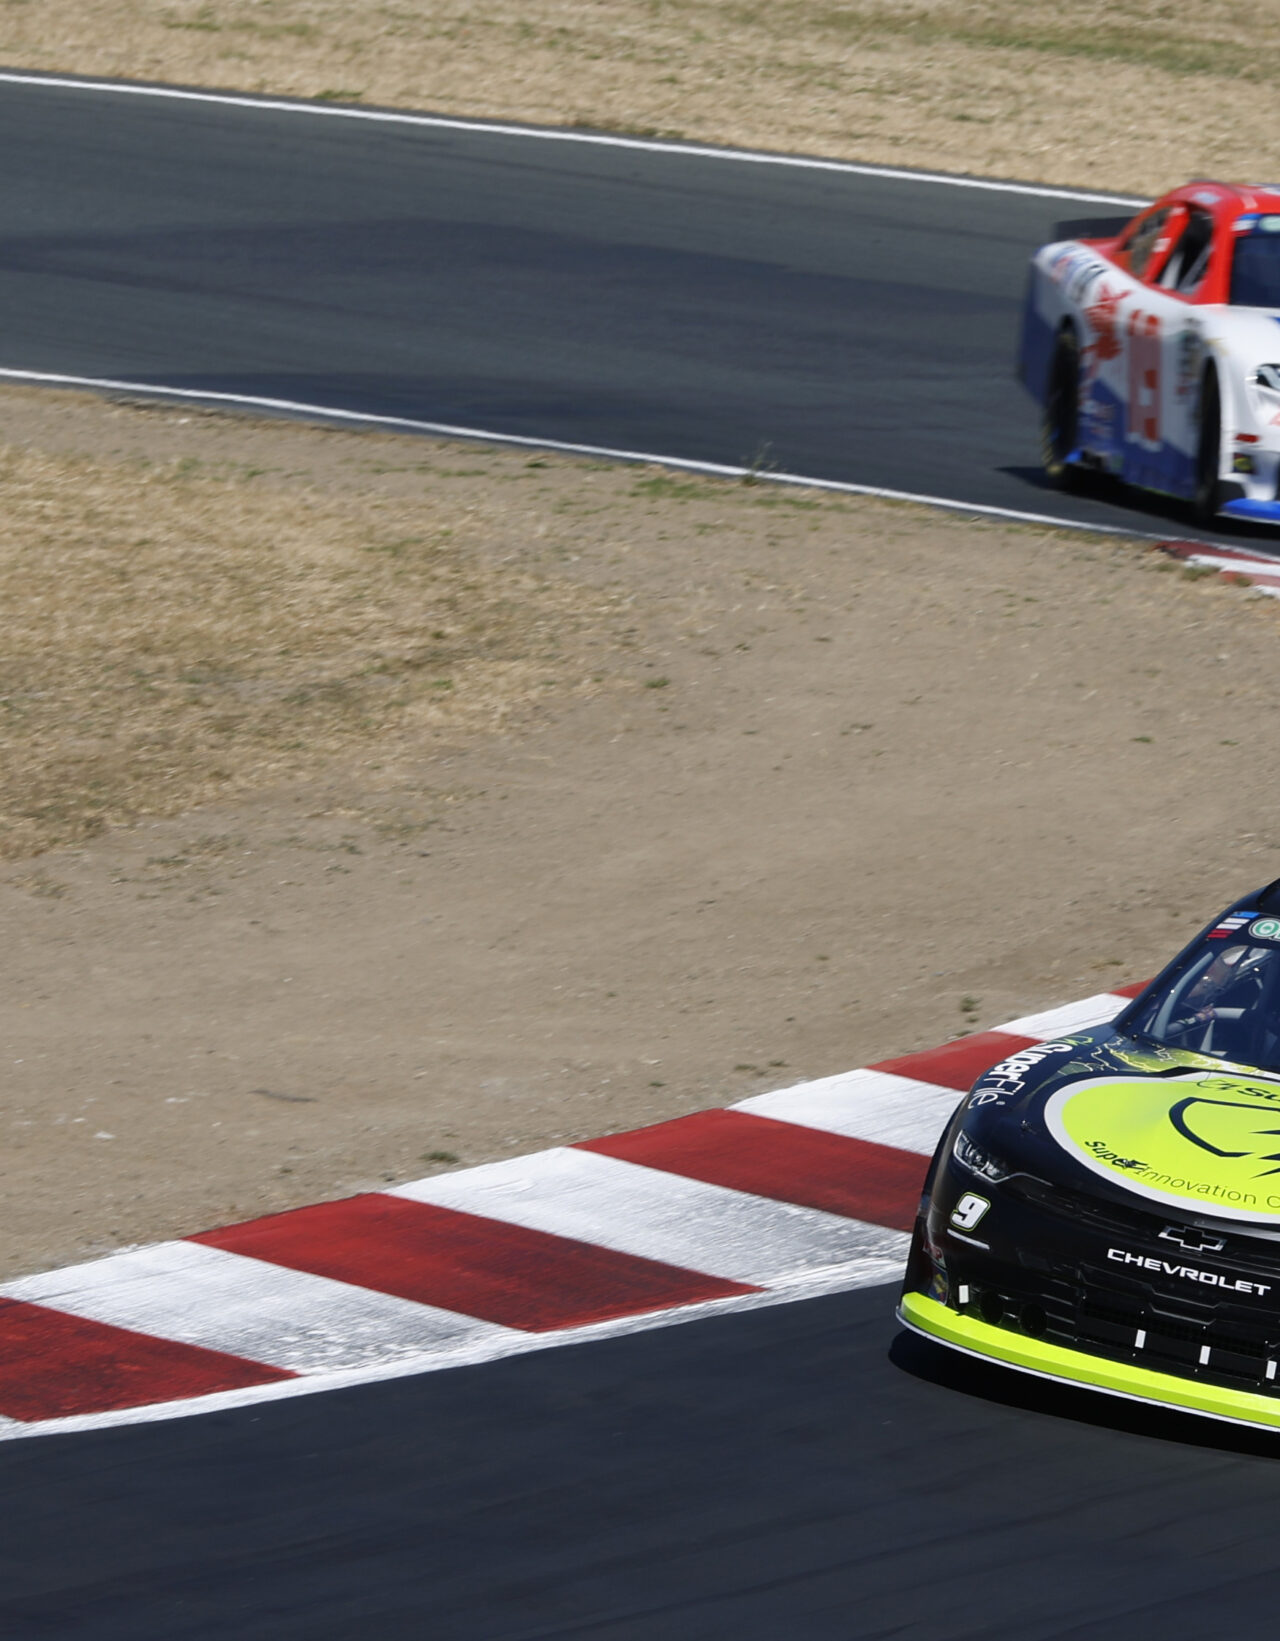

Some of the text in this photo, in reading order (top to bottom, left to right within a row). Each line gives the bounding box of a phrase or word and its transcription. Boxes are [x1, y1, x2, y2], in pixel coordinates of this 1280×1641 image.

[1084, 1141, 1141, 1170] Supe
[1136, 1166, 1257, 1206] Innovation
[952, 1194, 990, 1230] 9
[1107, 1248, 1271, 1296] CHEVROLET
